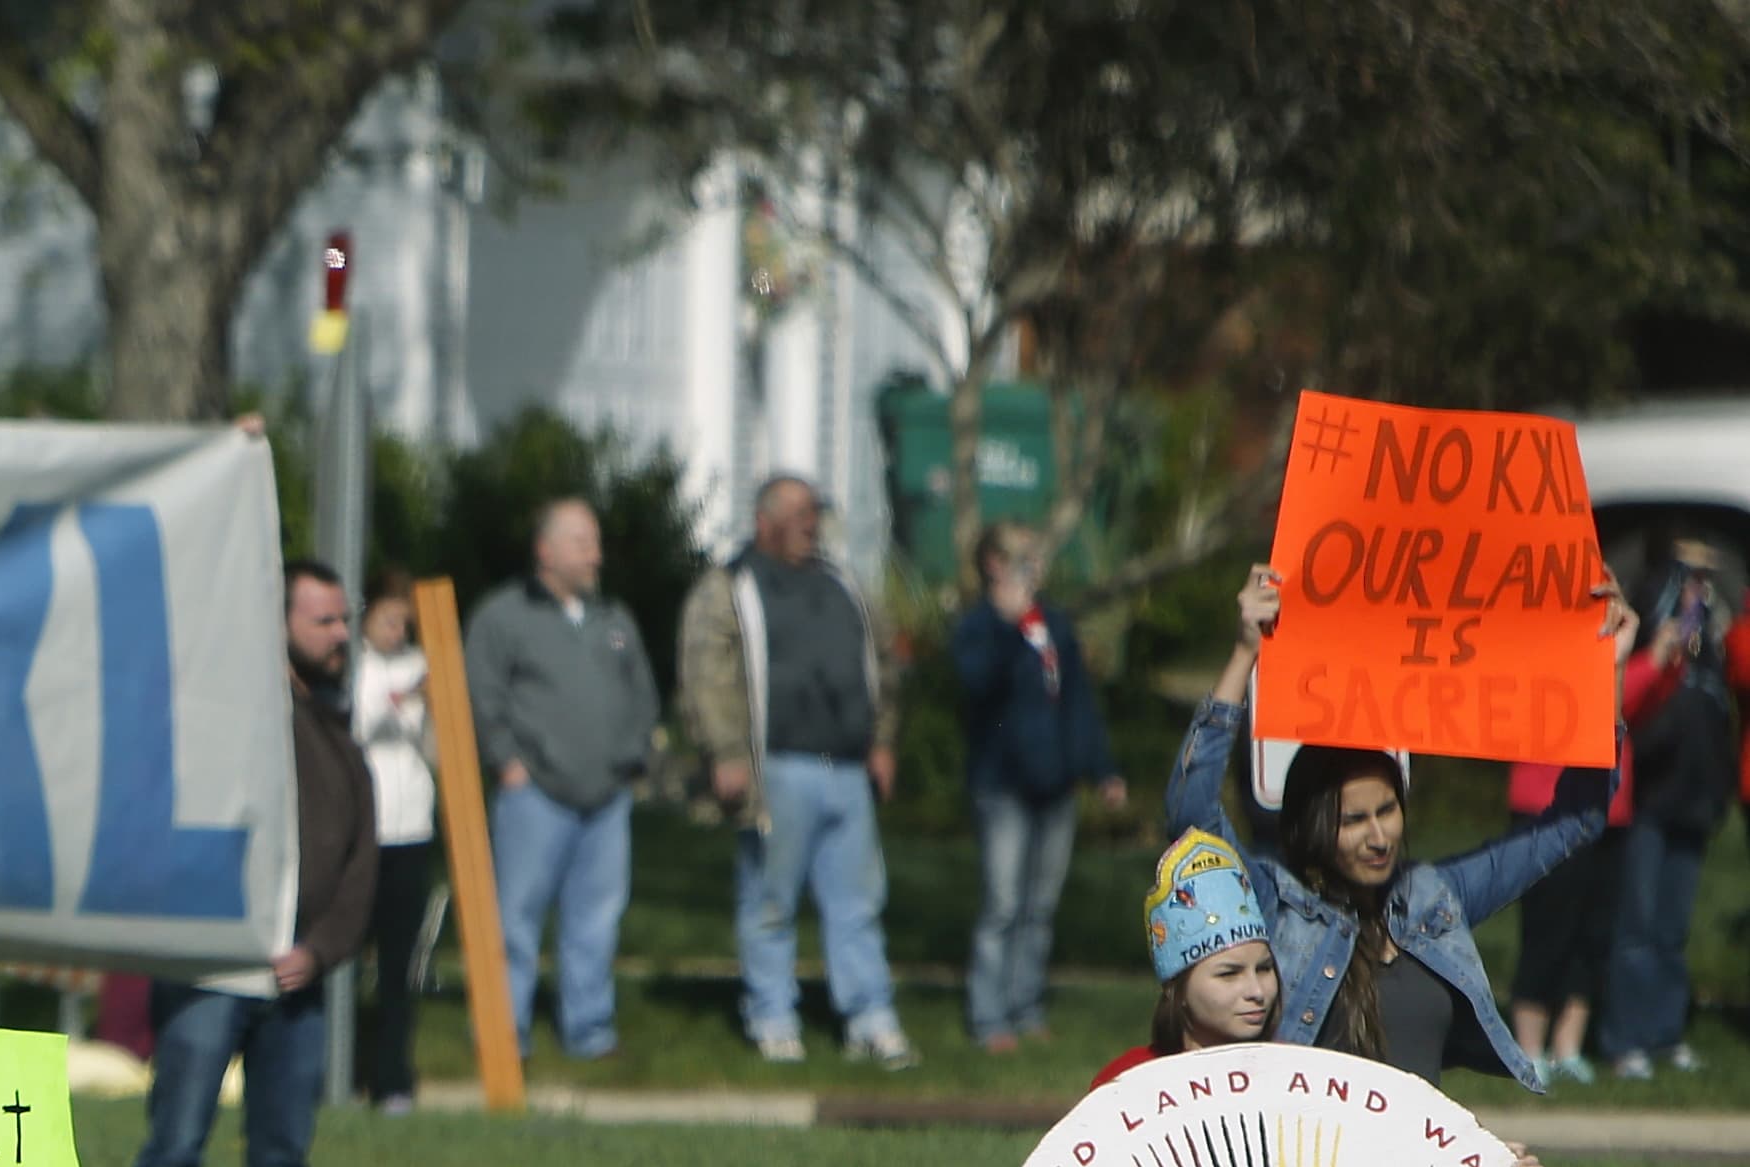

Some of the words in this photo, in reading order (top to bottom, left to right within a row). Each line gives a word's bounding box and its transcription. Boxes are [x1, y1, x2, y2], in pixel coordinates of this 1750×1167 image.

[1301, 519, 1445, 609] OUR
[1400, 615, 1482, 666] IS
[1295, 662, 1579, 758] SACRED
[1180, 933, 1226, 965] TOKA
[1120, 1070, 1250, 1132] LAND
[1288, 1072, 1389, 1113] AND
